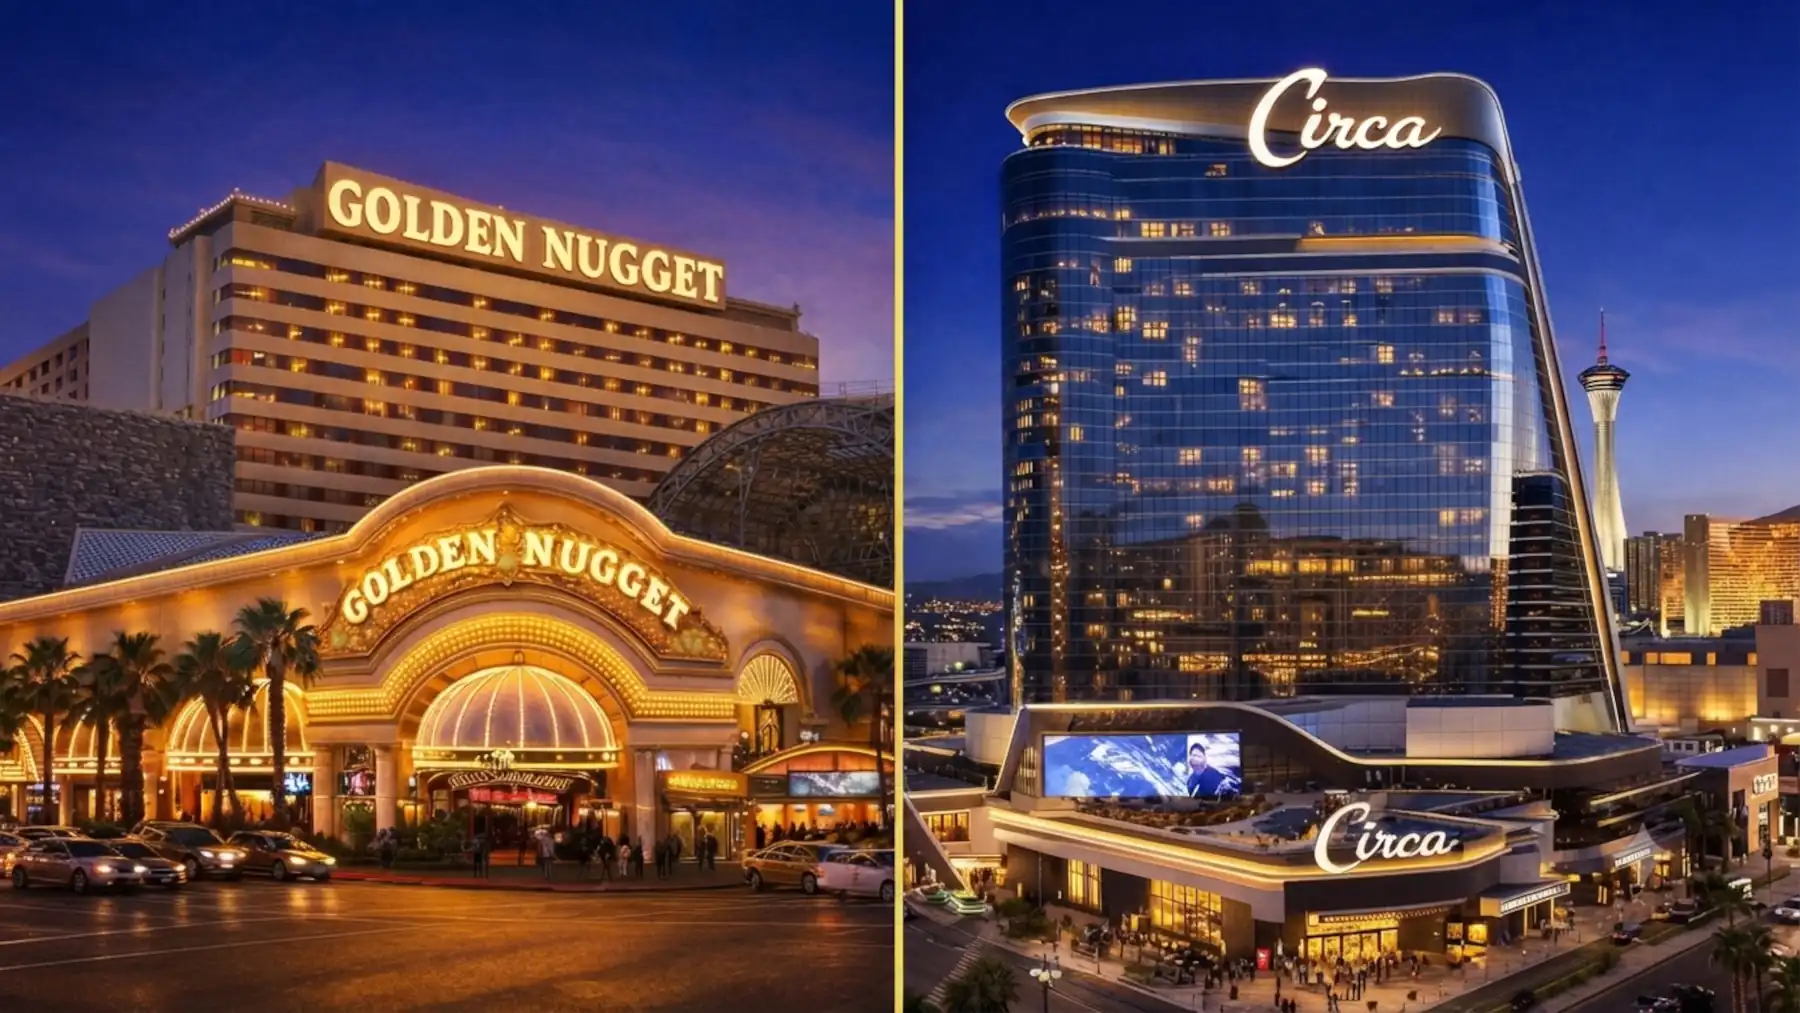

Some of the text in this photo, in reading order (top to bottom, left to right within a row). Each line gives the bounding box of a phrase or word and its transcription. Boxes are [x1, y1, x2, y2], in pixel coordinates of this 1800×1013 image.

[1248, 67, 1442, 168] Circa
[328, 179, 723, 302] GOLDEN NUGGET
[342, 528, 690, 630] GOLDEN NUGGET
[1314, 802, 1460, 874] Circa
